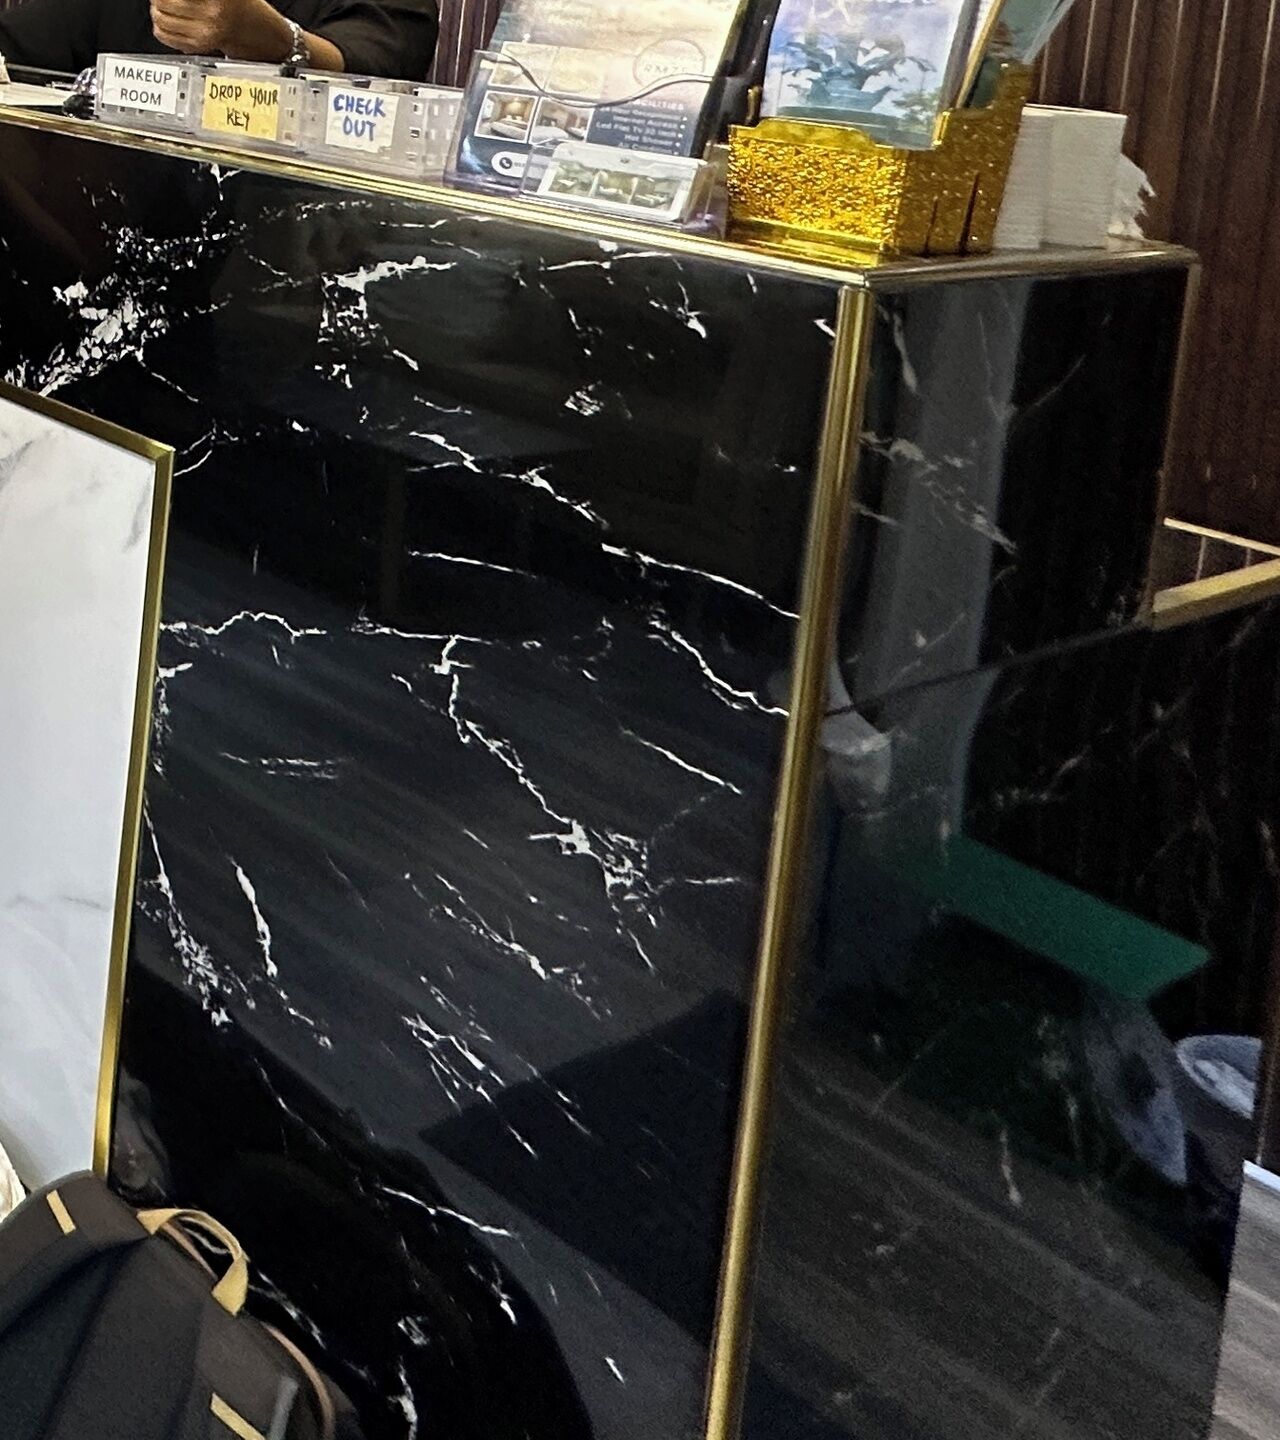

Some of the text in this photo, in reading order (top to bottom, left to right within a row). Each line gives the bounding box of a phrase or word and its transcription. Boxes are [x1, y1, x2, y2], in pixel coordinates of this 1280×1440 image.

[114, 66, 172, 85] MAKEUP
[120, 88, 162, 106] ROOM
[208, 82, 279, 108] DROP YOUR
[333, 93, 387, 118] CHECK
[226, 107, 250, 132] KEY
[343, 115, 377, 142] OUT
